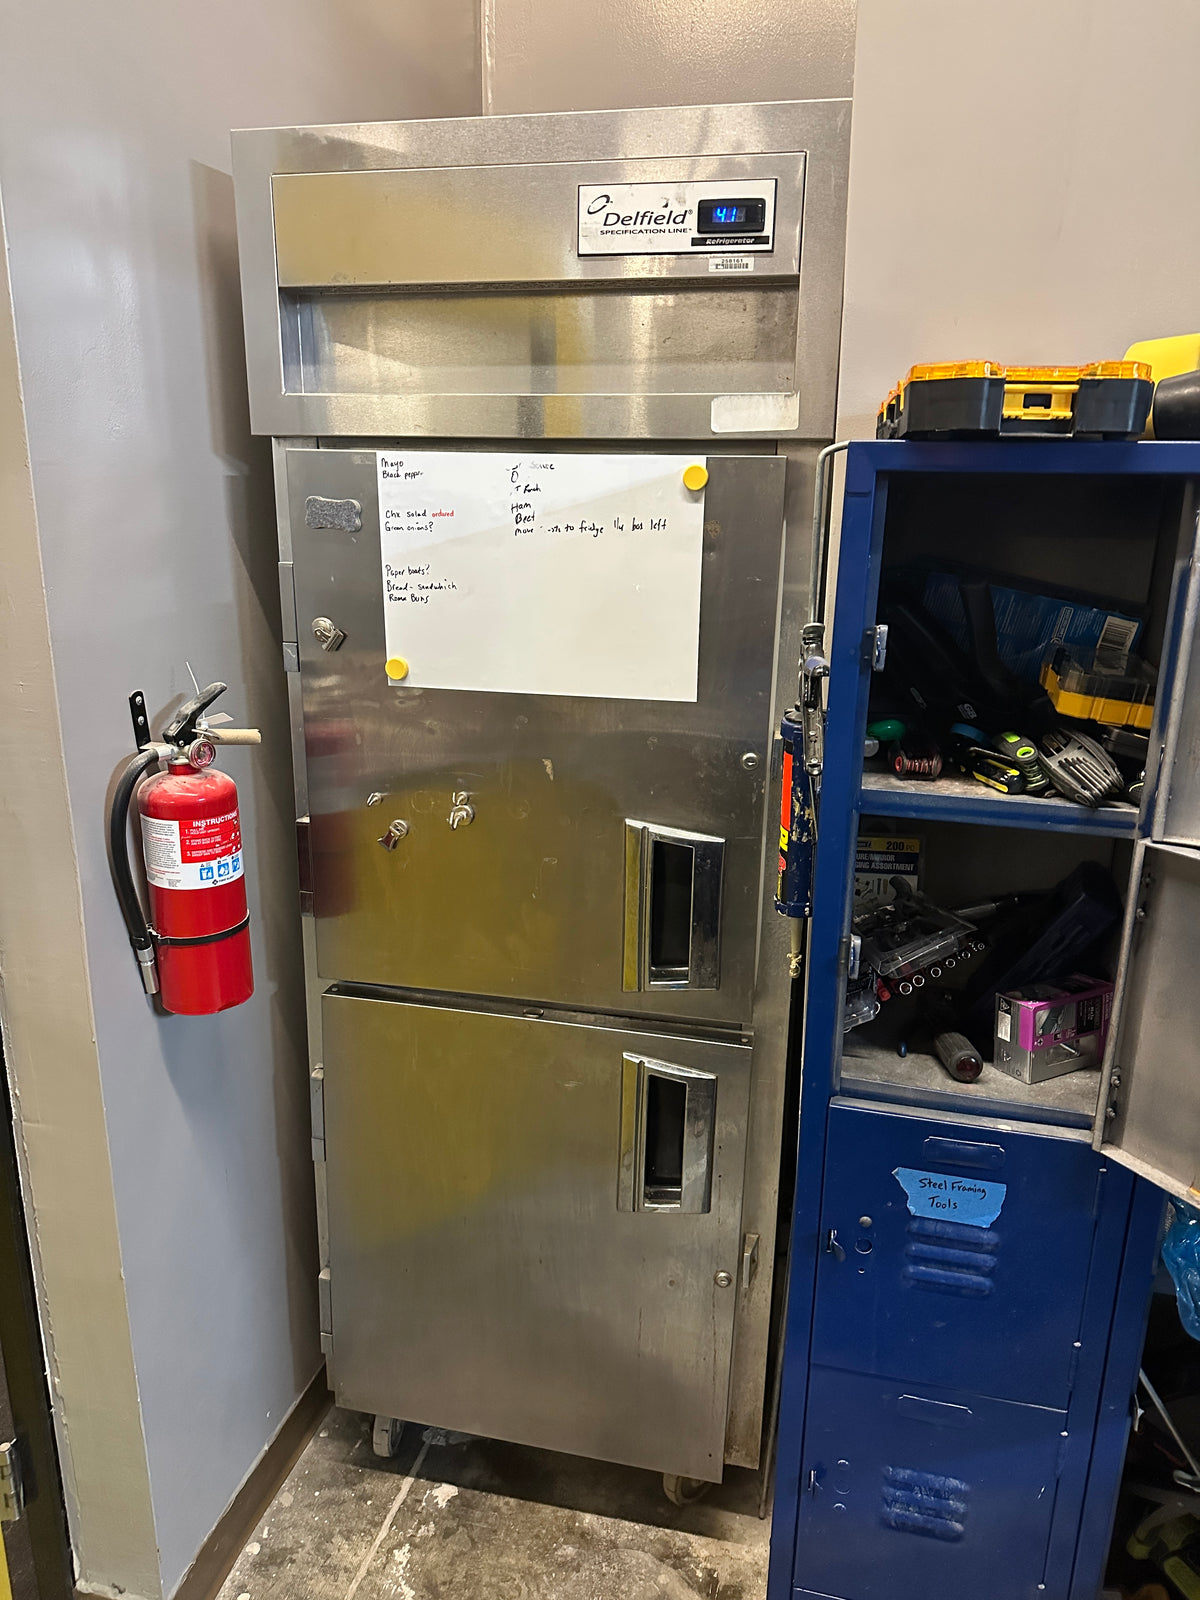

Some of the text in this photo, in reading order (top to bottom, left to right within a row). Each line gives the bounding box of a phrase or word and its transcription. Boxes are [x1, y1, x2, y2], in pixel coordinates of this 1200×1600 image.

[715, 206, 737, 223] 41
[600, 228, 666, 236] SPECIFICATION
[706, 237, 755, 246] Refrigerator
[381, 457, 405, 472] Mayo
[382, 470, 401, 479] Black
[406, 508, 427, 518] salad
[510, 502, 532, 514] Ham
[564, 523, 575, 532] to
[578, 519, 604, 538] fridge
[650, 518, 667, 531] left
[385, 563, 405, 579] Paper
[410, 593, 430, 605] Buns
[886, 841, 905, 851] 200
[856, 853, 895, 862] URE/MIRROR
[871, 862, 914, 871] ASSORTMENT
[919, 1178, 987, 1200] Steel Framing
[928, 1195, 958, 1209] Tools
